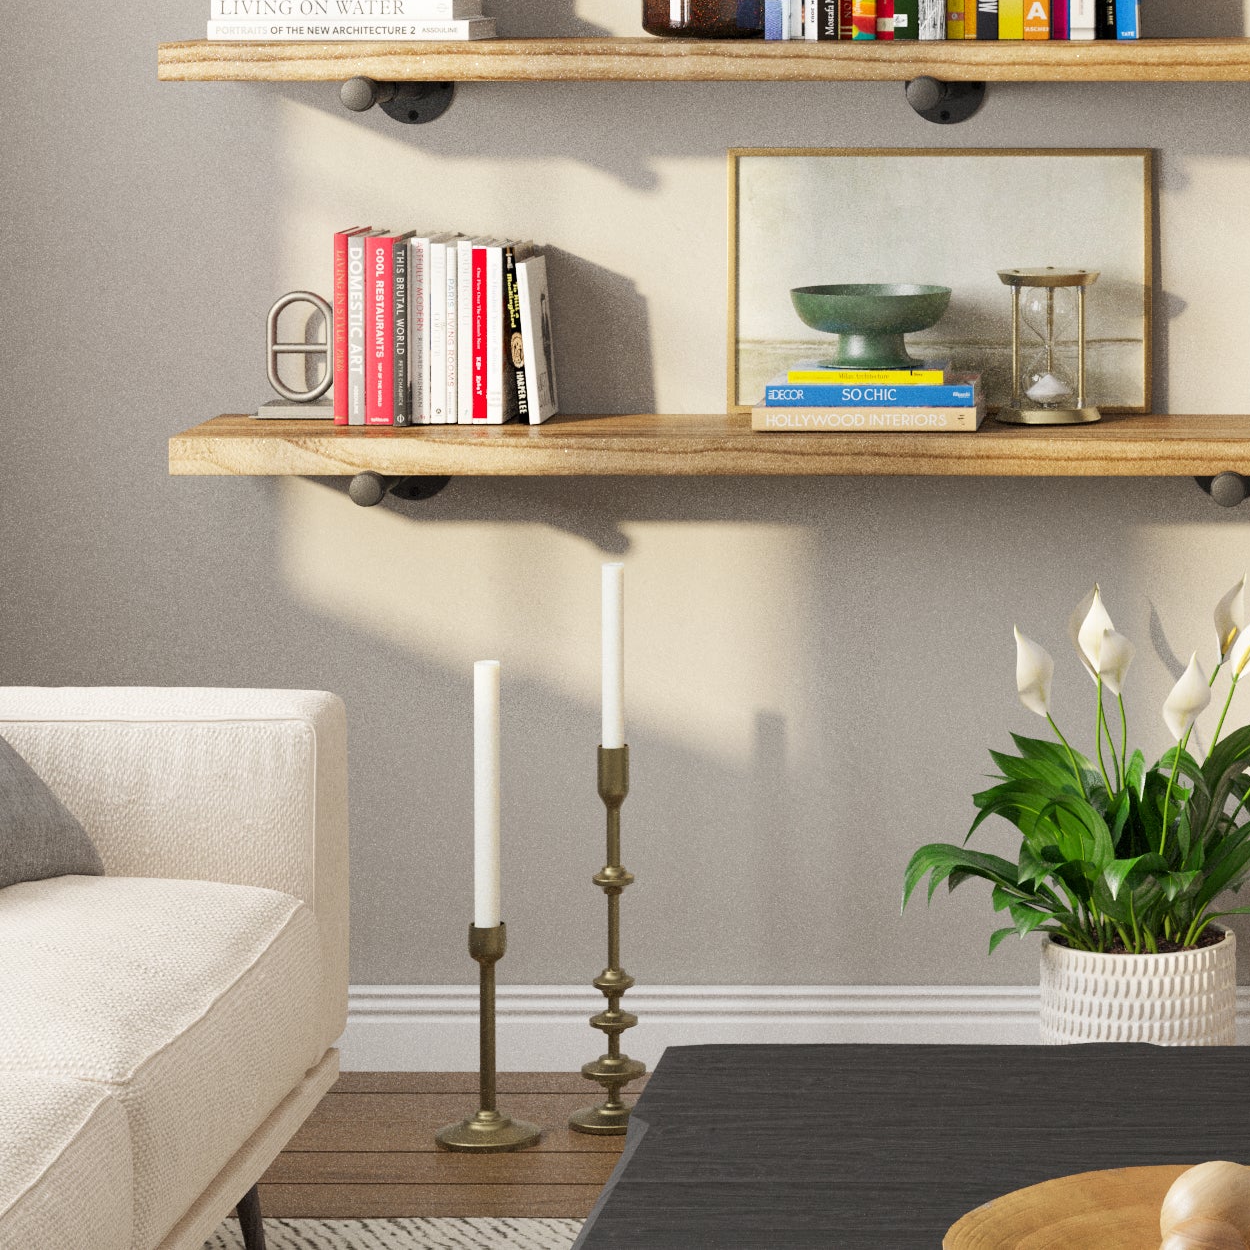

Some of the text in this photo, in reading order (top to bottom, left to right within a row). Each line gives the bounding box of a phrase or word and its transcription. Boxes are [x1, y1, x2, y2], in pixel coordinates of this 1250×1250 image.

[220, 0, 405, 15] LIVING ON WATER
[824, 4, 836, 36] Mostafa
[1026, 2, 1048, 20] A
[1106, 6, 1114, 26] NAME
[216, 26, 416, 34] PORTRAITS OF THE NEW ARCHITECTURE 2
[336, 250, 346, 344] LIVING IN STYLE
[375, 248, 385, 358] COOL RESTAURANTS
[396, 250, 405, 355] THIS BRUTAL WORLD
[416, 242, 424, 332] ARTFULLY MODERN
[506, 273, 516, 328] Mockingbird
[348, 247, 364, 374] DOMESTIC ART
[516, 371, 528, 414] HARPER LEE
[772, 390, 804, 400] DECOR
[842, 388, 897, 401] SO CHIC
[766, 414, 865, 427] HOLLYWOOD
[870, 414, 948, 427] INTERIORS
